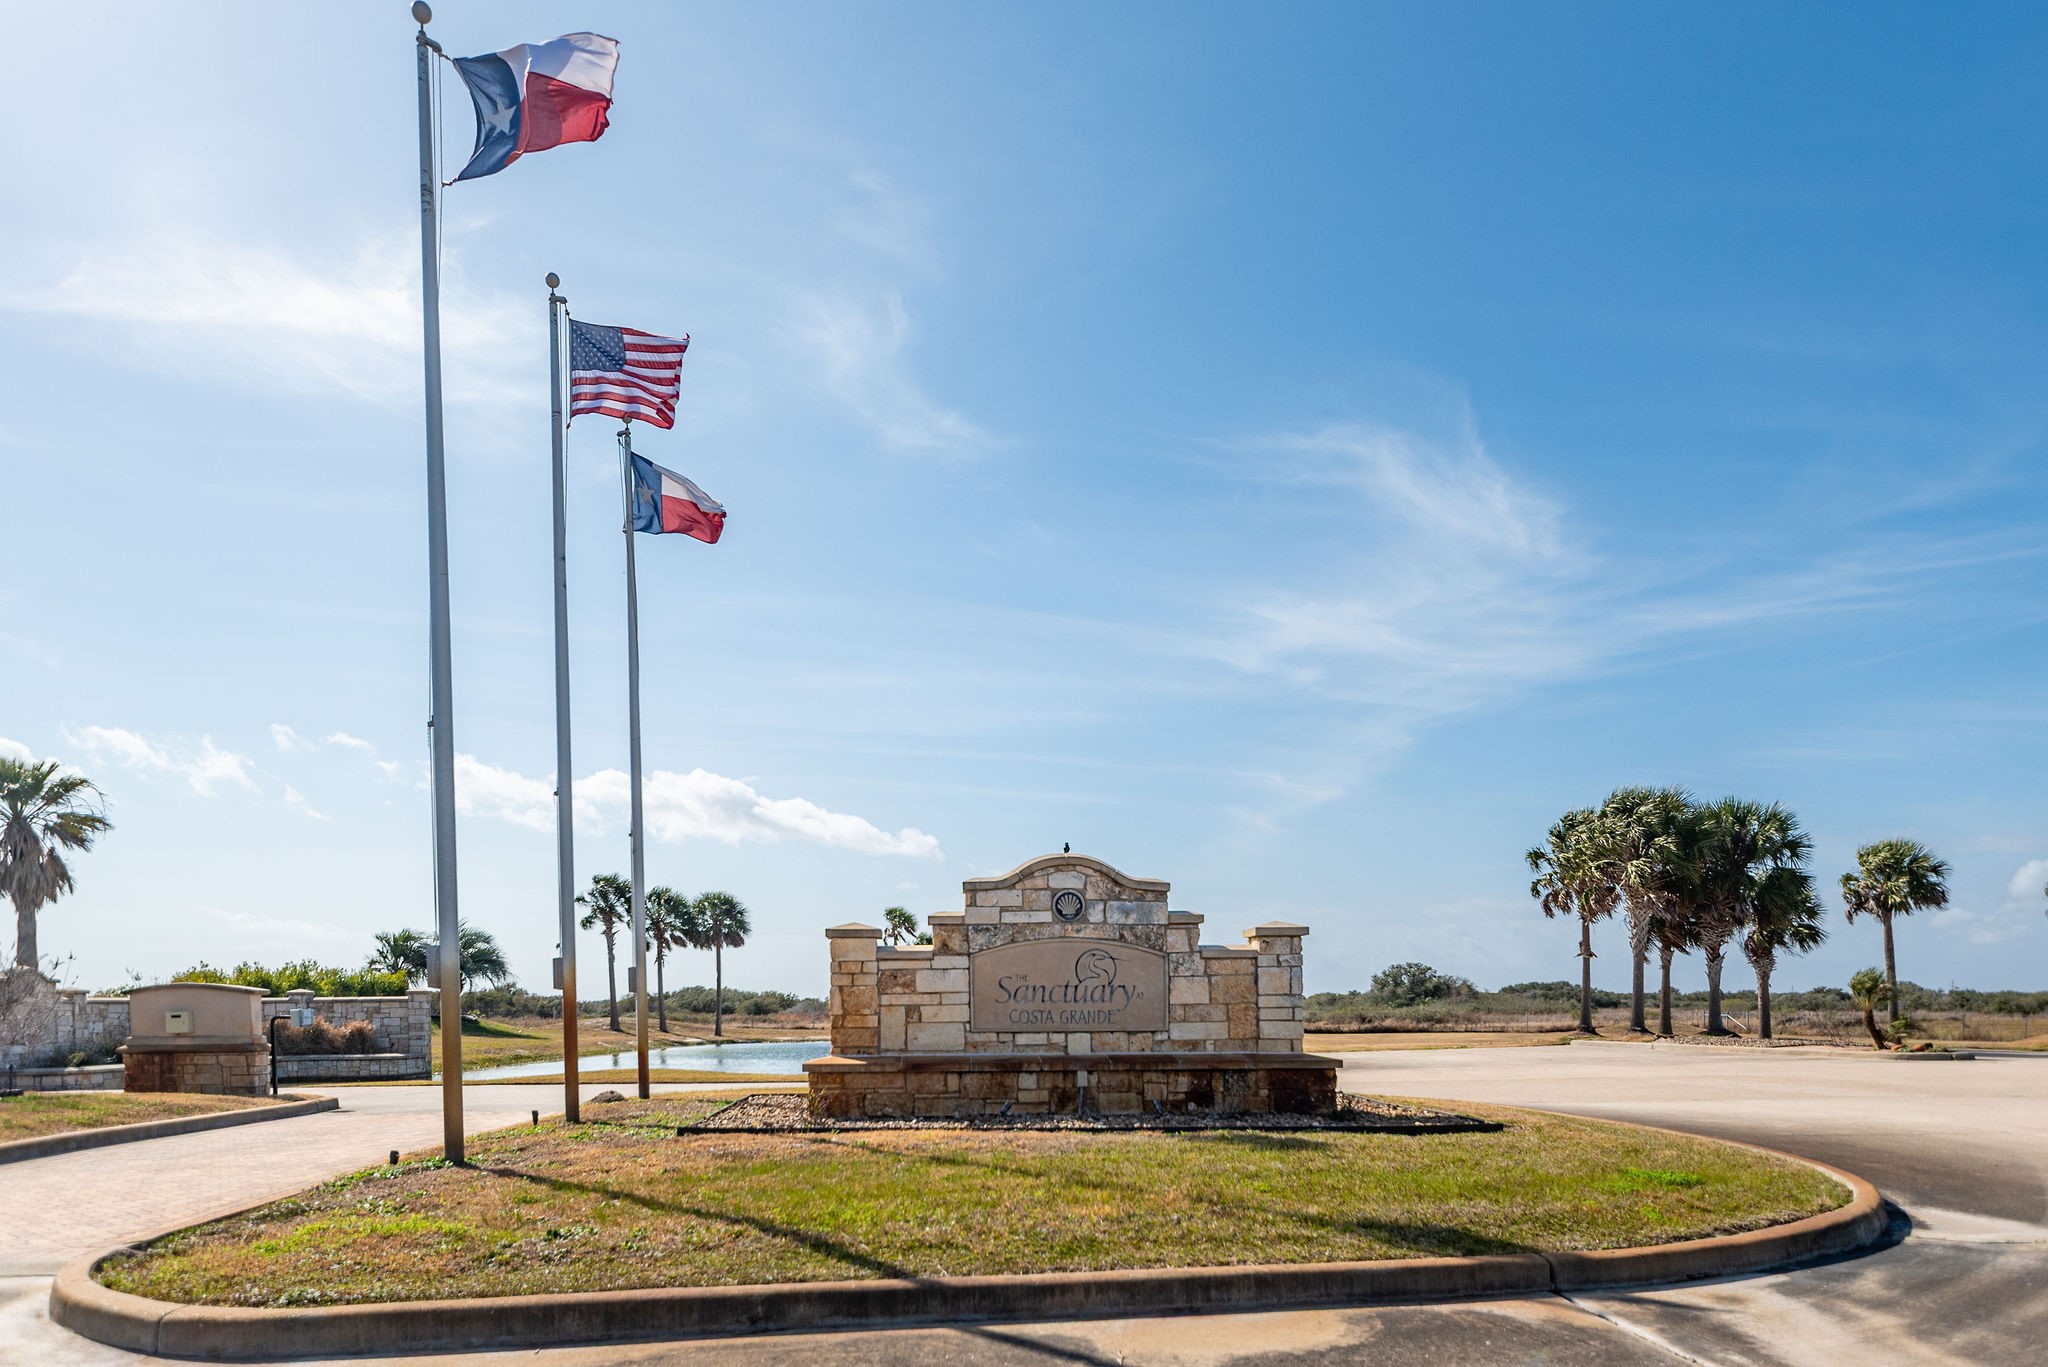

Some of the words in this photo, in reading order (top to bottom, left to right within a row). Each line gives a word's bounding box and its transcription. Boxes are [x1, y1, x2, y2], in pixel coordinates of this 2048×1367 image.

[1016, 973, 1028, 982] THE
[995, 975, 1136, 1012] Sanctuary
[1136, 992, 1144, 1001] AT
[1009, 1008, 1054, 1025] COSTA
[1059, 1009, 1117, 1025] GRANDE
